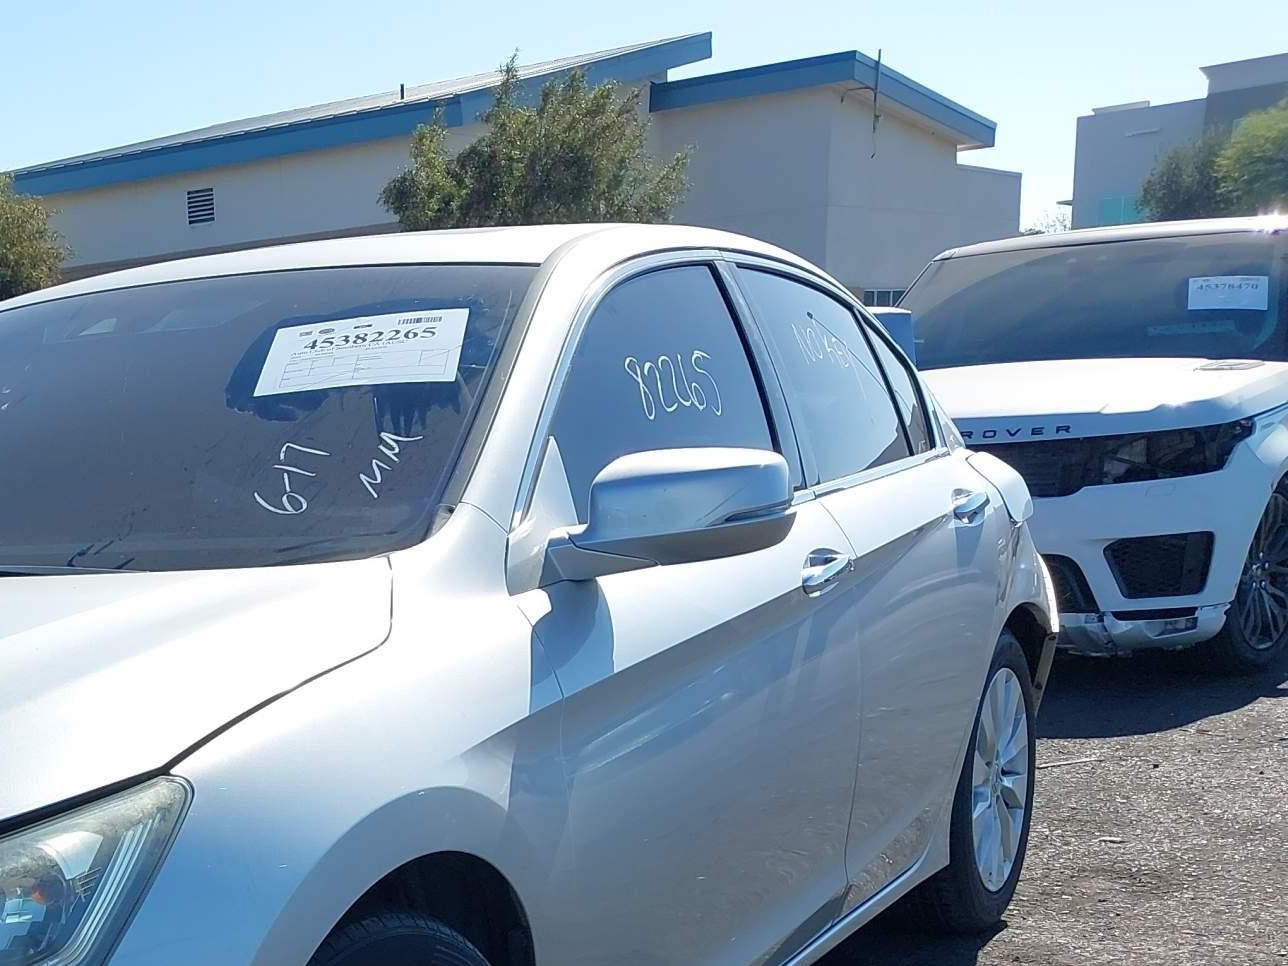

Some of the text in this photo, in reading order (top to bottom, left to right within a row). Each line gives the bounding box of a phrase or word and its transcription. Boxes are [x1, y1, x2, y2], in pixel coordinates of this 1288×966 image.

[303, 326, 438, 350] 45382265
[624, 350, 722, 421] 82265
[961, 425, 1072, 439] ROVER
[254, 442, 332, 515] 6-17
